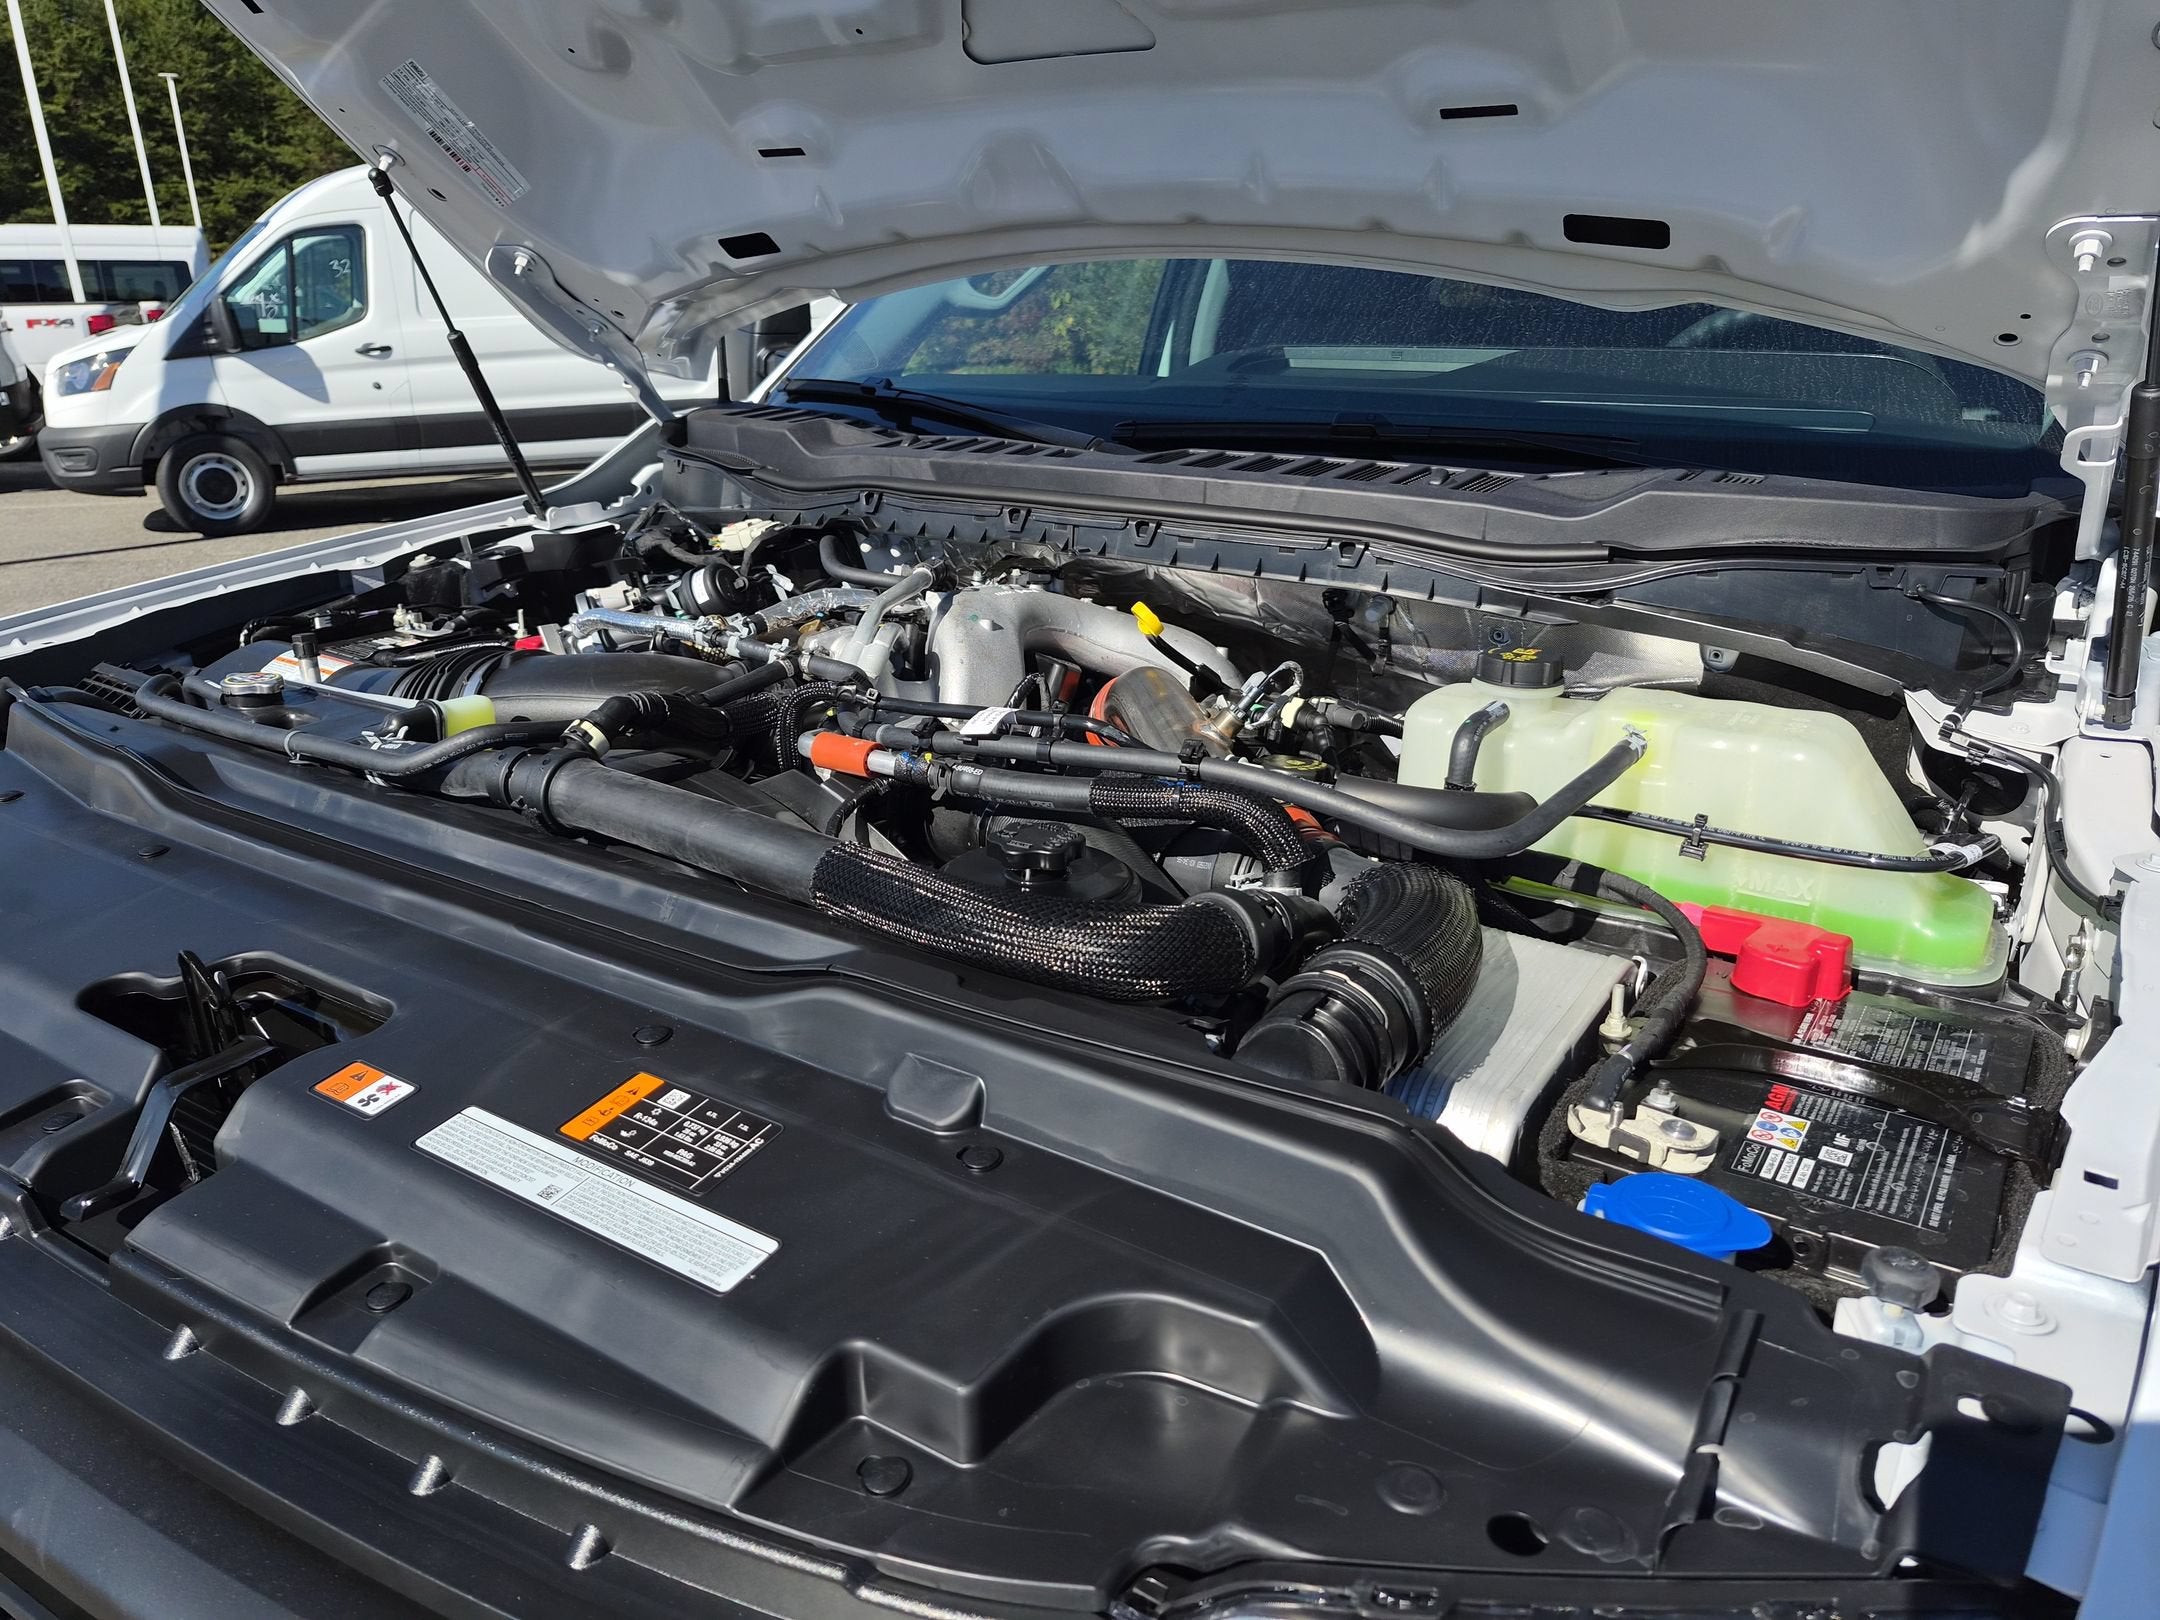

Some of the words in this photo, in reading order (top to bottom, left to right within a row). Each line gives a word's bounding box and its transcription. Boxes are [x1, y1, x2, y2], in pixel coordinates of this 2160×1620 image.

[329, 258, 352, 278] 32
[26, 318, 74, 329] FX4
[1749, 869, 1815, 901] MAX
[1764, 1084, 1791, 1110] AGM
[633, 1112, 658, 1126] R-134a
[589, 1134, 618, 1151] FoMoCo
[1833, 1132, 1850, 1148] MF
[1737, 1143, 1760, 1172] FoMoCo
[574, 1156, 636, 1187] MODIFICATION
